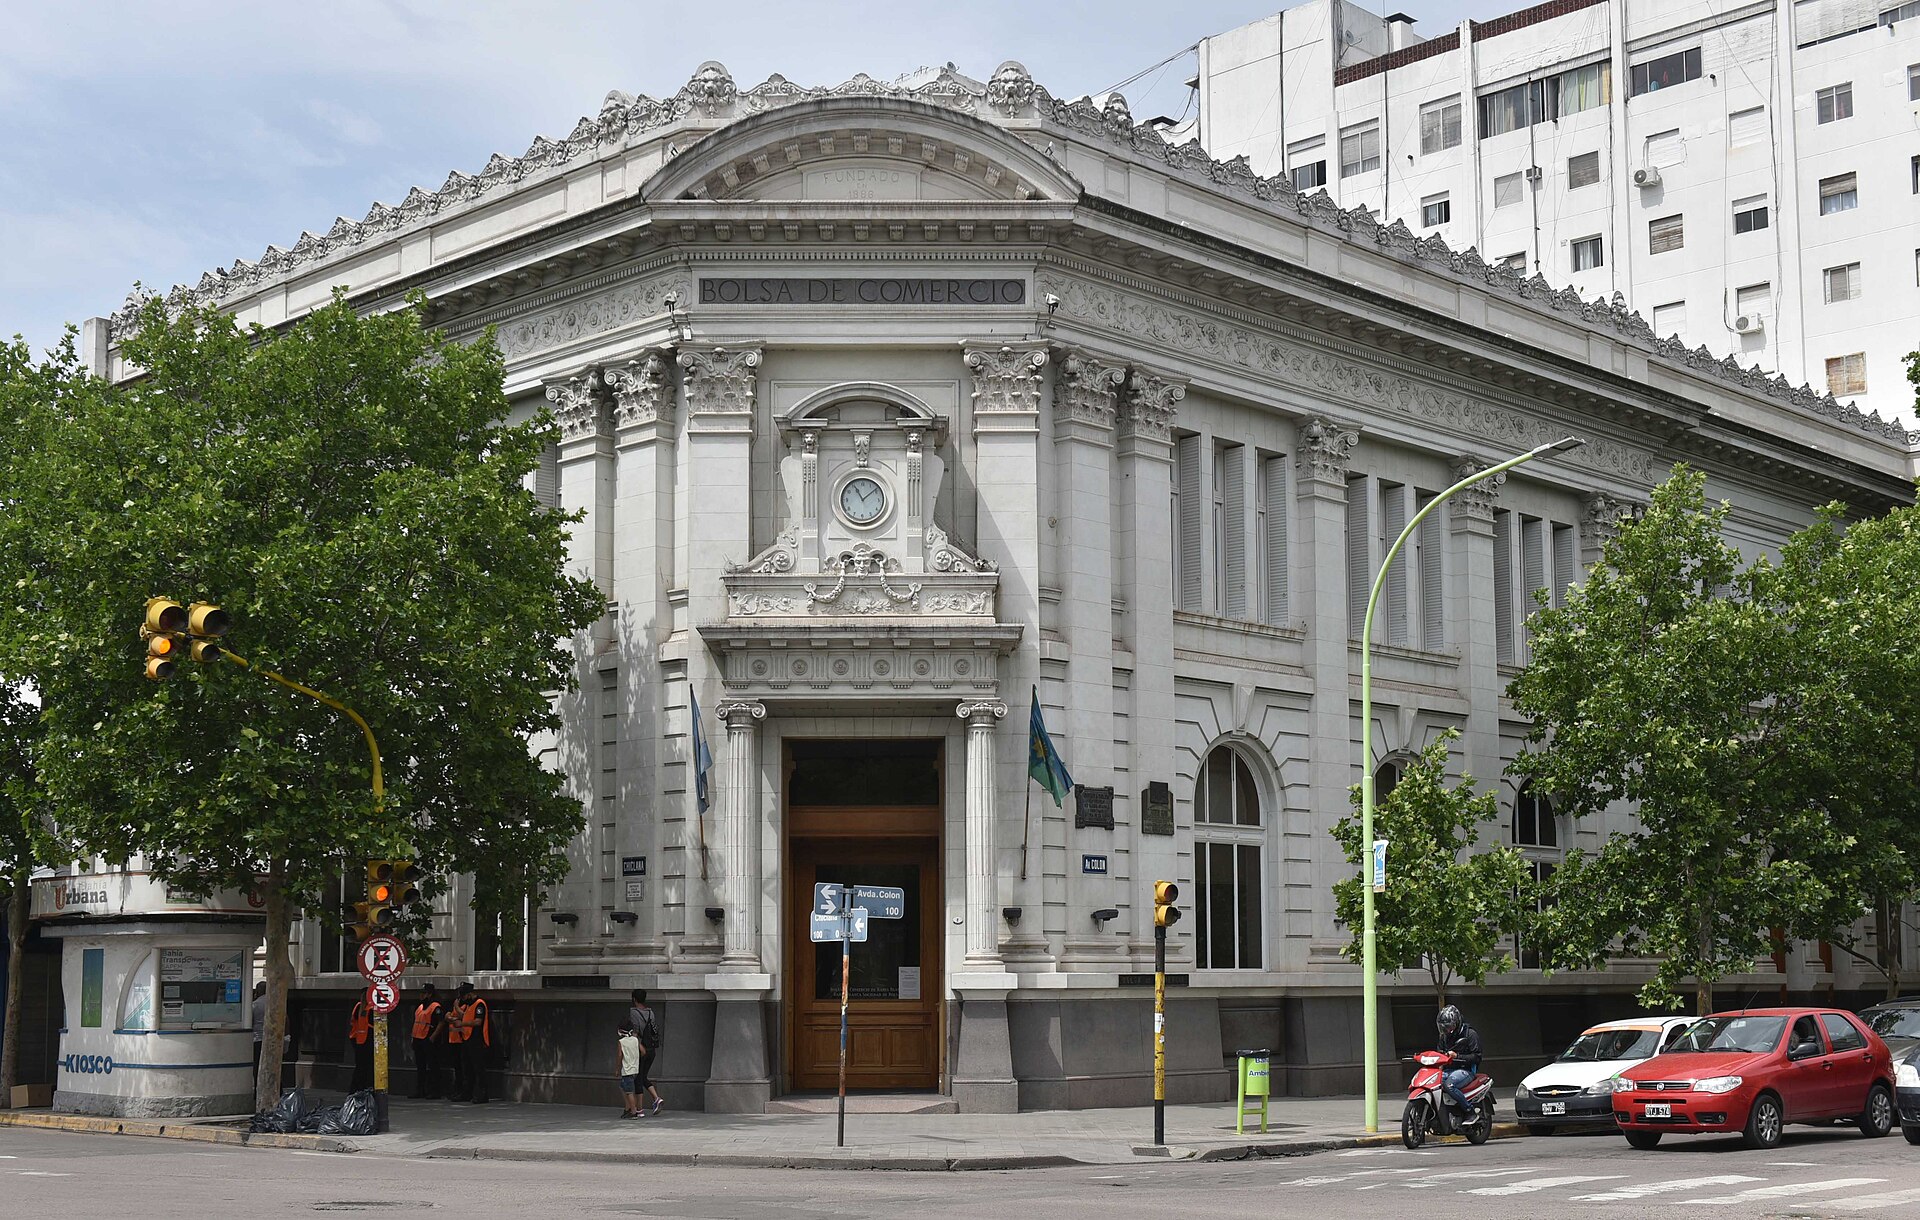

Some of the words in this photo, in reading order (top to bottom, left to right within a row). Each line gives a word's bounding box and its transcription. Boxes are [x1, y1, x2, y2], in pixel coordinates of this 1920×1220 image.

[823, 170, 900, 184] FUNDADO
[702, 279, 794, 302] BOLSA
[808, 279, 846, 302] DE
[858, 279, 1024, 303] COMERCIO
[1091, 859, 1106, 870] COLON
[55, 884, 108, 910] Urbana
[885, 907, 899, 916] 100
[813, 930, 823, 939] 100
[65, 1053, 113, 1075] KIOSCO
